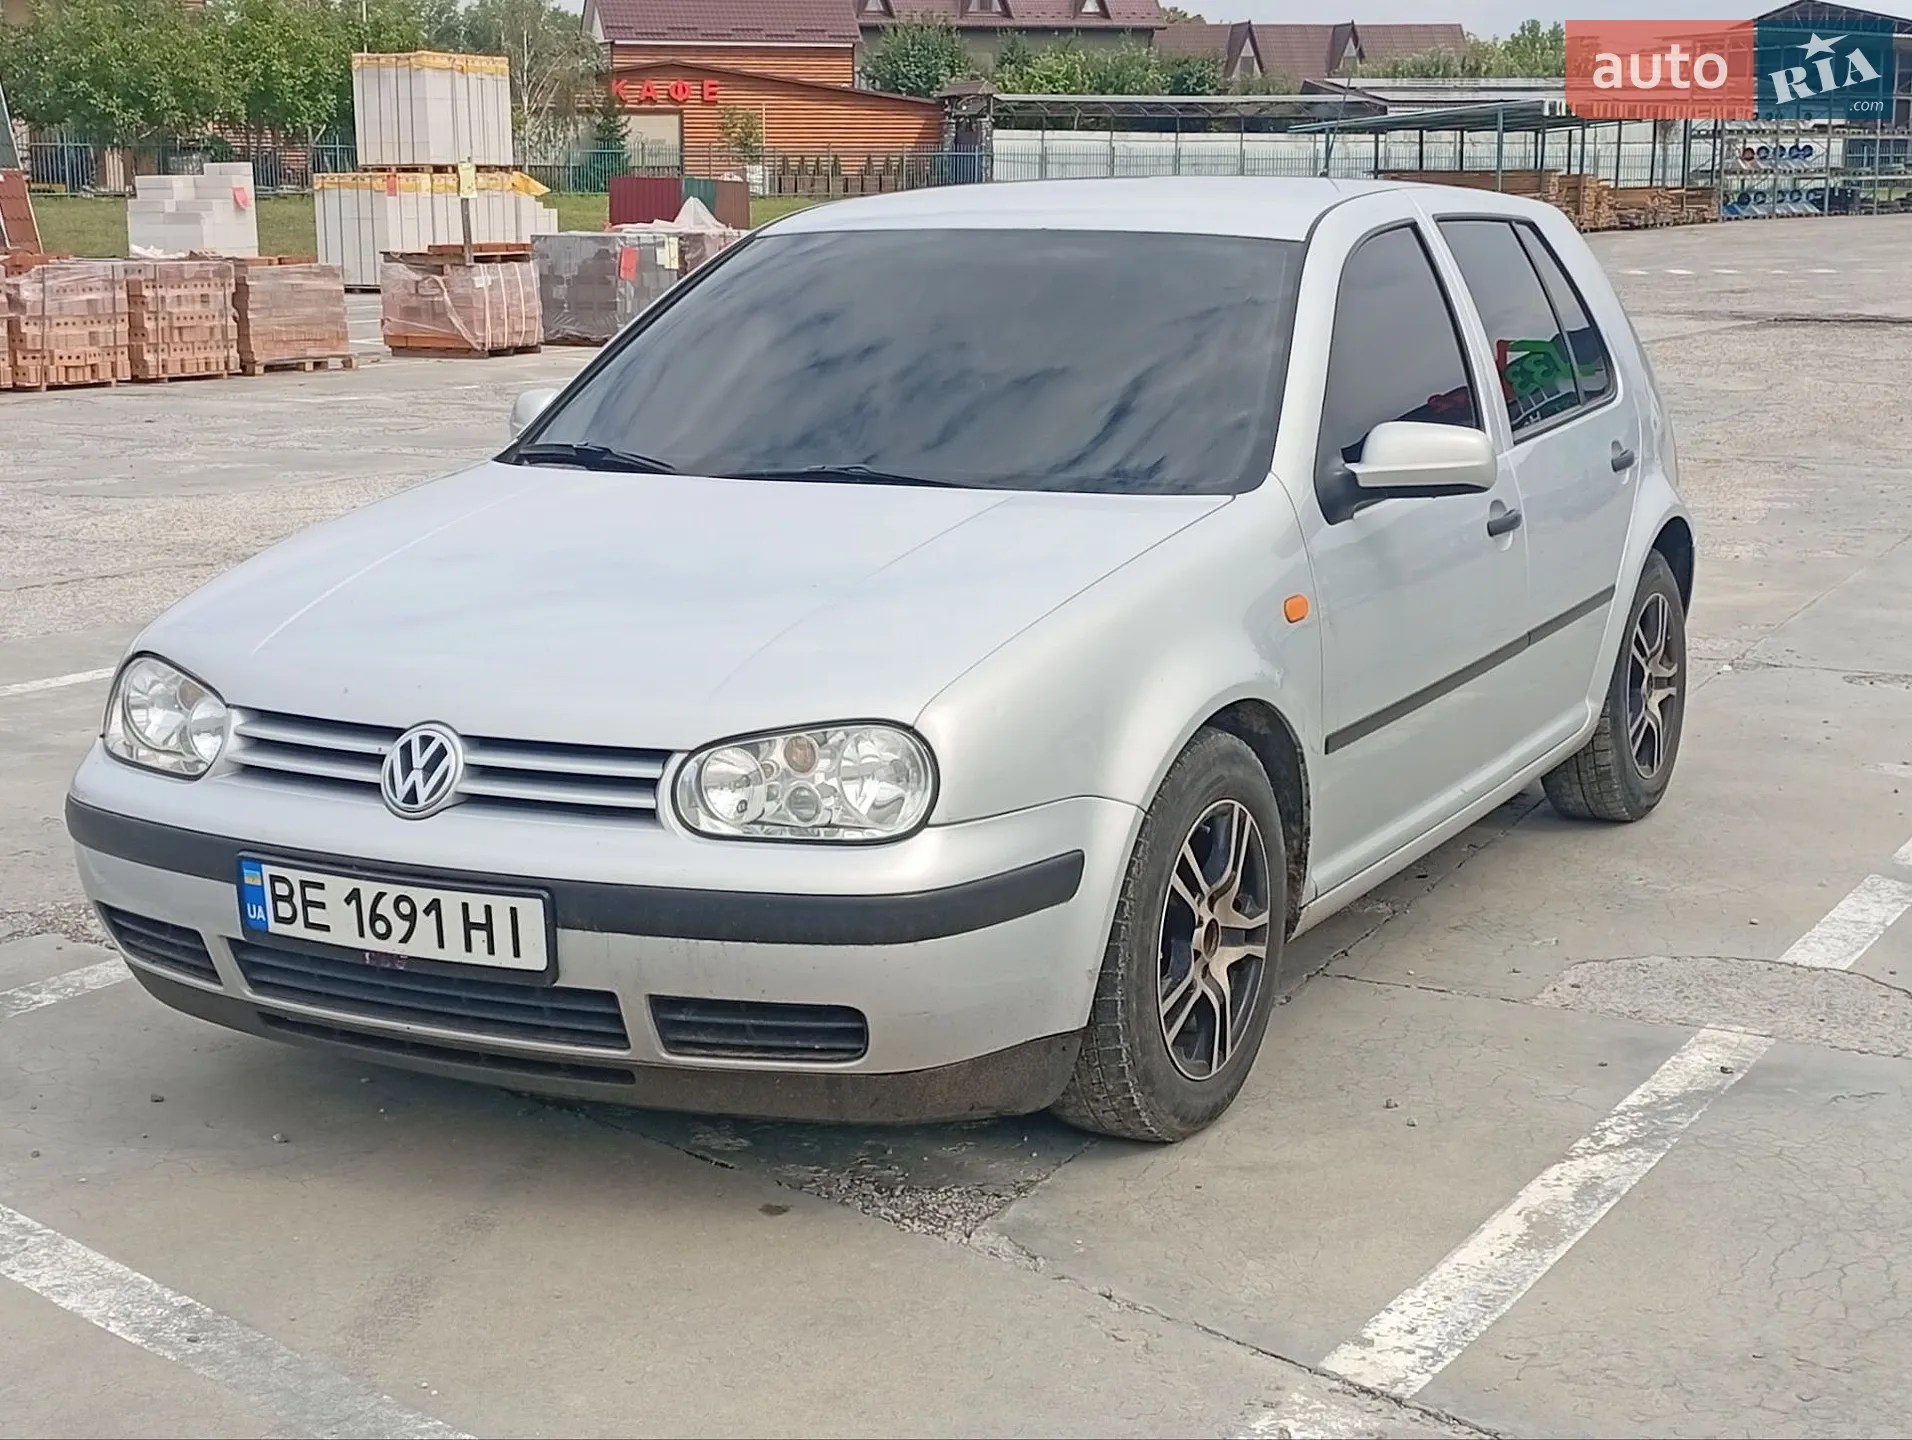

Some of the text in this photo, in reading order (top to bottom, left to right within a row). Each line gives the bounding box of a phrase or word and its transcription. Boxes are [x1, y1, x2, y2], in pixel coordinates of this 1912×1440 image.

[612, 79, 719, 103] КАФЕ
[247, 903, 266, 921] UA
[269, 874, 521, 958] BE 1691 HI
